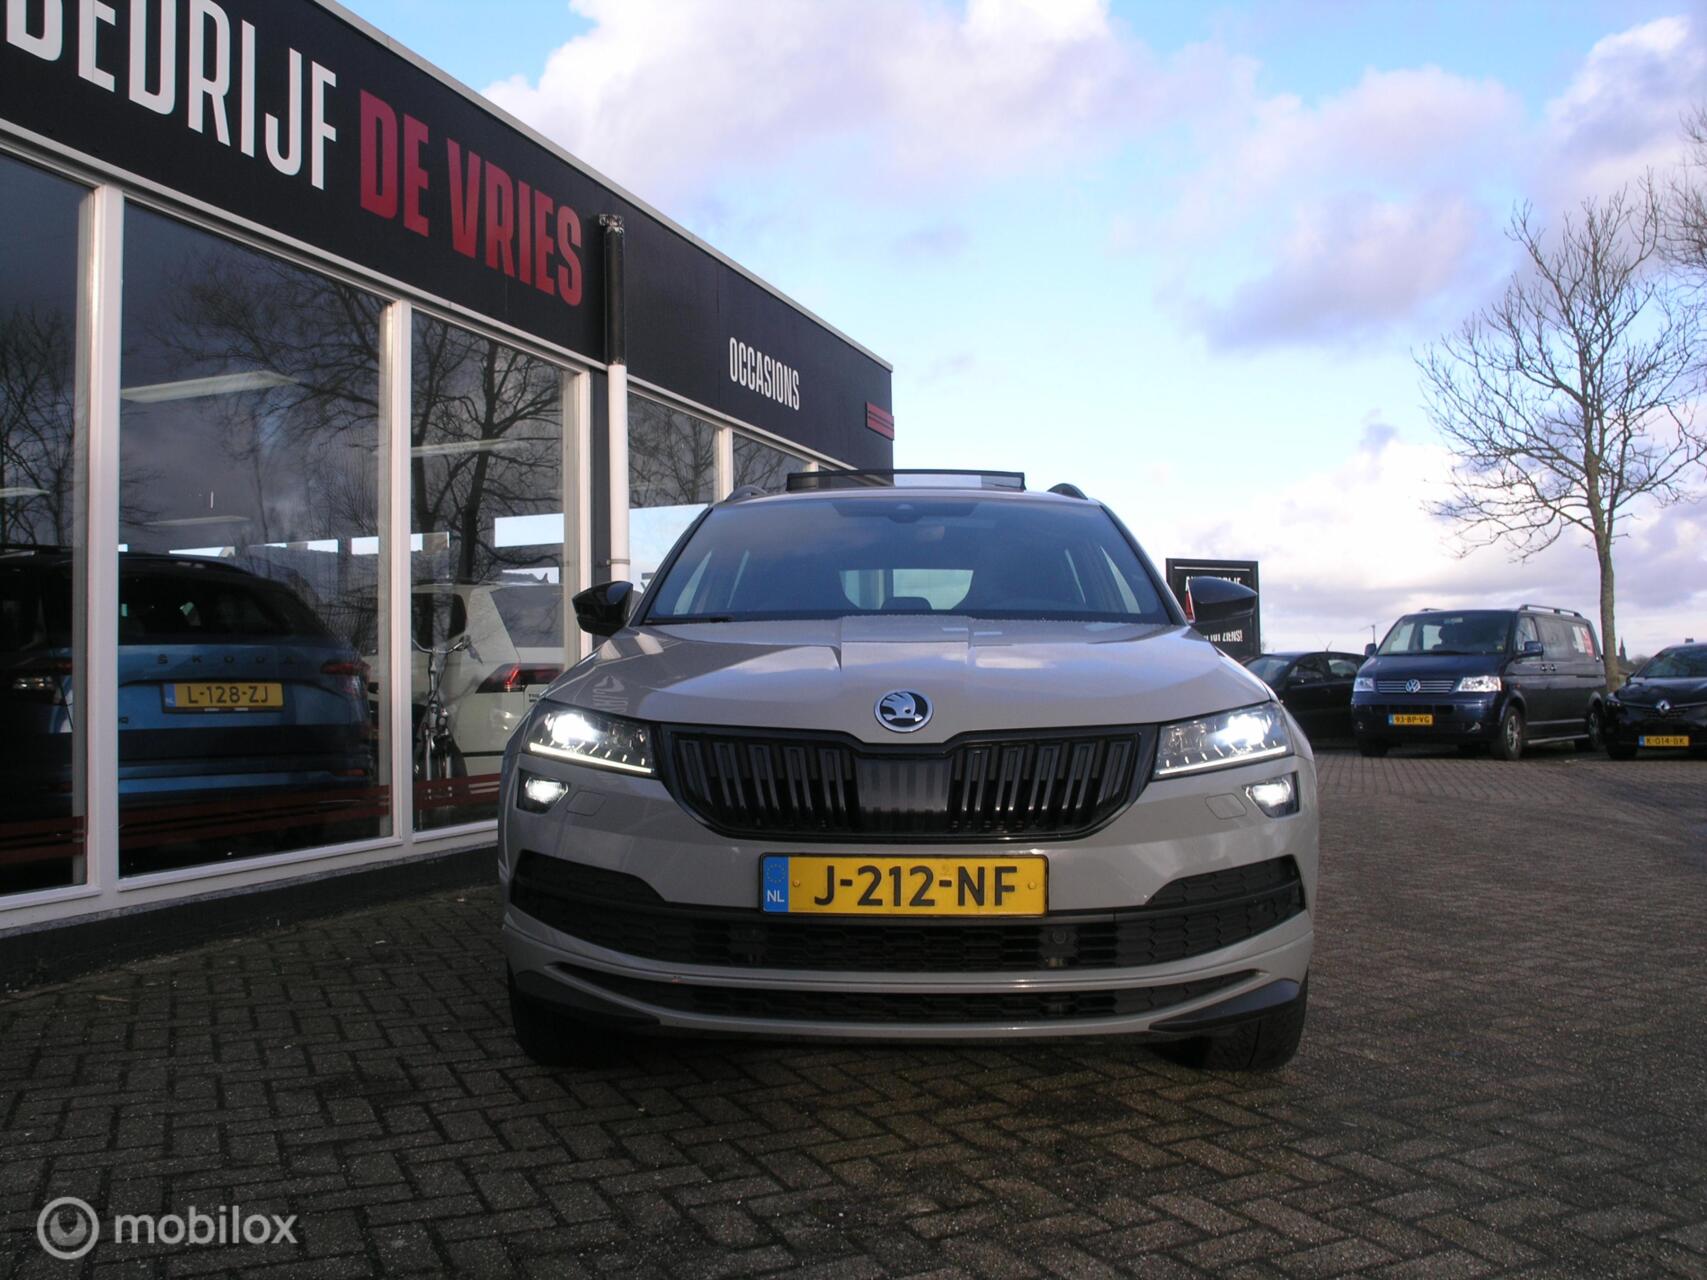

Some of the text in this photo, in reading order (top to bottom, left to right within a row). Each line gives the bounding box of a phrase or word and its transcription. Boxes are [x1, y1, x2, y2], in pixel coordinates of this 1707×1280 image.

[360, 90, 429, 237] DE
[447, 138, 582, 307] VRIES
[729, 337, 800, 411] OCCASIONS
[187, 685, 269, 704] L-128-ZJ
[767, 865, 1018, 907] NL J-212-NF
